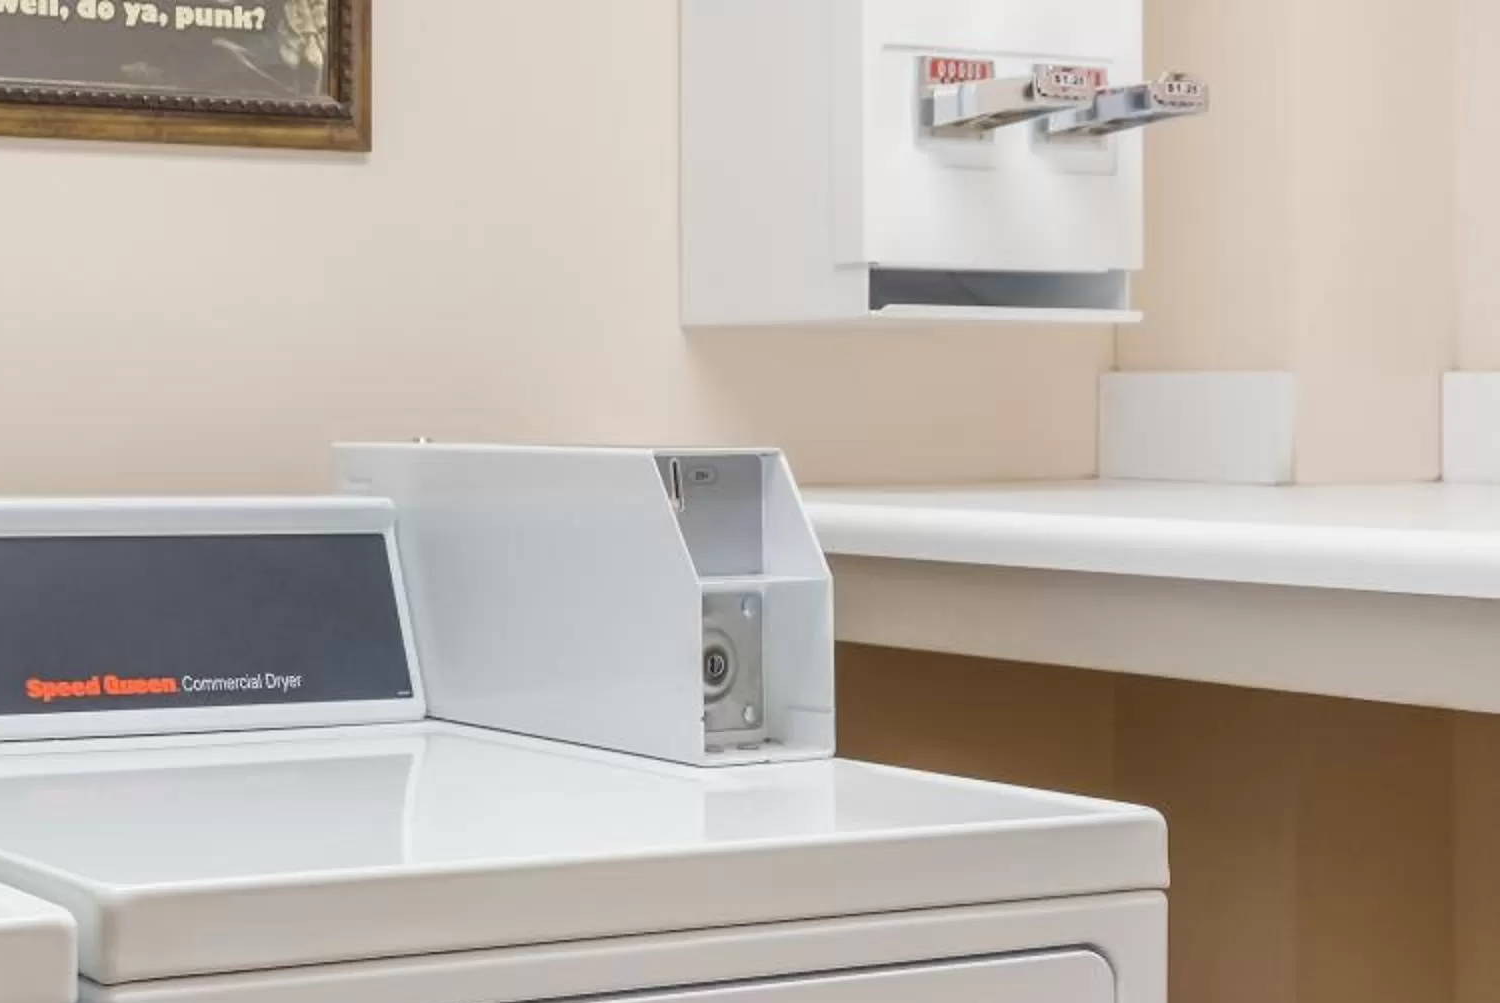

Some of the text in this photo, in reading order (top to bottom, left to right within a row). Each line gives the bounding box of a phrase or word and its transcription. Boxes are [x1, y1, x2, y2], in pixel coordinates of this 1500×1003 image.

[76, 0, 115, 20] do
[123, 1, 168, 27] ya,
[175, 5, 266, 30] punk?
[25, 672, 303, 702] Speed Queen Commercial Dryer
